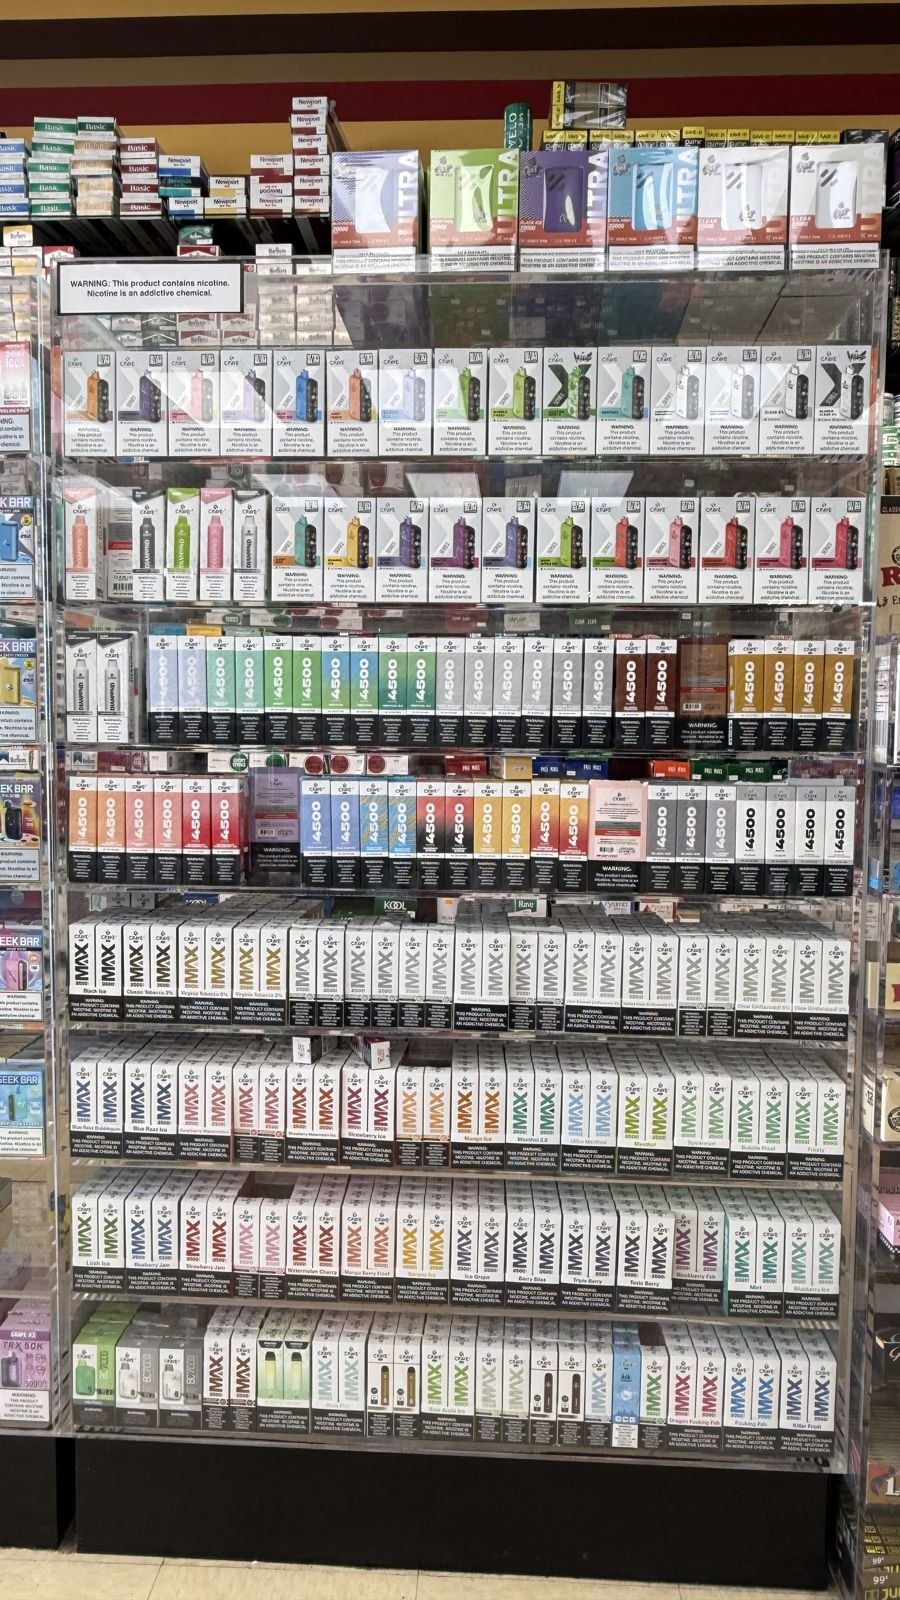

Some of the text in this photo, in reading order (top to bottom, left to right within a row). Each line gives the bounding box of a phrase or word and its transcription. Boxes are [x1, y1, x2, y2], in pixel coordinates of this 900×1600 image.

[509, 112, 517, 148] VELO
[586, 150, 608, 236] ULTRA
[130, 280, 160, 289] product
[140, 289, 174, 297] addictive
[176, 289, 212, 297] chemical.
[9, 497, 32, 508] BAR
[12, 641, 34, 652] BAR
[216, 656, 226, 699] 4500
[302, 657, 311, 699] 4500
[417, 659, 425, 700] 4500
[563, 660, 572, 701] 4500
[657, 660, 667, 702] 4500
[834, 662, 844, 704] 4500
[14, 784, 34, 793] BAR
[192, 800, 200, 840] 4500
[221, 800, 229, 840] 4500
[370, 801, 379, 843] 4500
[426, 803, 435, 844] 4500
[455, 804, 464, 845] 4500
[657, 807, 667, 848] 4500
[746, 808, 755, 849] 4500
[776, 808, 785, 850] 4500
[806, 809, 815, 850] 4500
[835, 809, 845, 850] 4500
[384, 900, 406, 910] KOOL
[0, 936, 39, 946] EEK BAR
[74, 943, 88, 980] MAX
[129, 945, 144, 981] MAX
[21, 1076, 38, 1084] BAR
[76, 1080, 90, 1117] MAX
[293, 1087, 306, 1124] MAX
[375, 1089, 388, 1126] MAX
[485, 1091, 499, 1130] MAX
[513, 1092, 527, 1130] MAX
[104, 1217, 118, 1255] MAX
[186, 1220, 200, 1256] MAX
[212, 1220, 226, 1257] MAX
[735, 1240, 749, 1277] MAX
[763, 1241, 778, 1279] MAX
[209, 1356, 223, 1393] MAX
[236, 1357, 250, 1394] MAX
[675, 1374, 690, 1411] MAX
[702, 1376, 717, 1413] MAX
[758, 1377, 774, 1415] MAX
[814, 1380, 830, 1417] MAX
